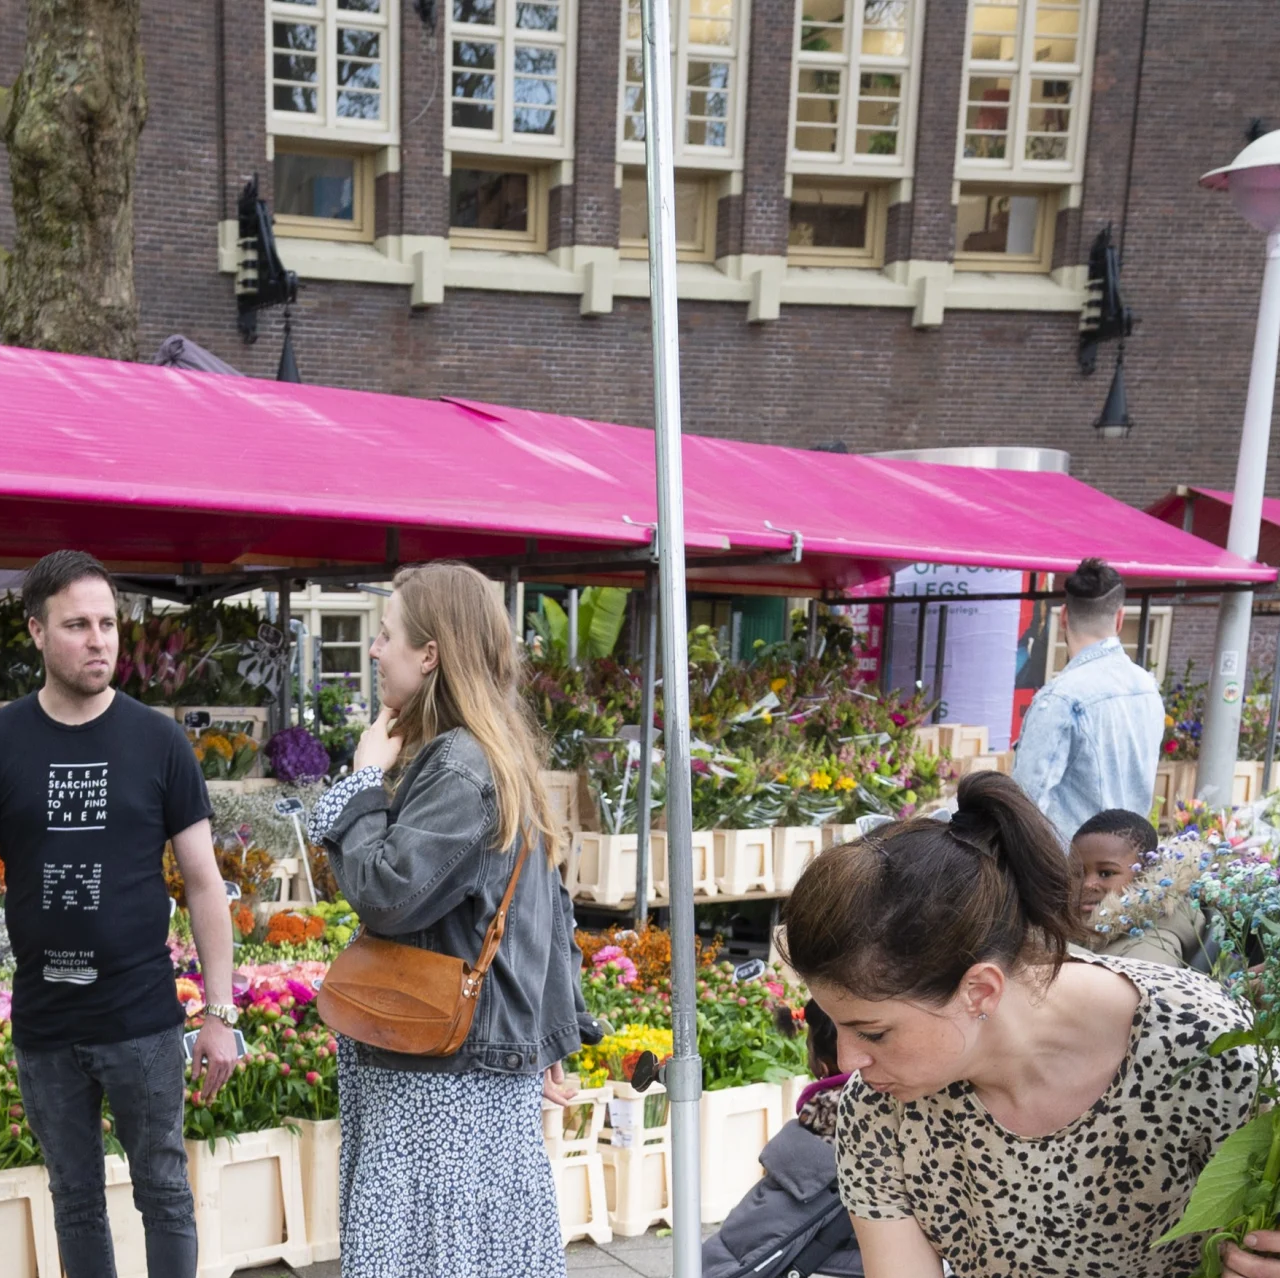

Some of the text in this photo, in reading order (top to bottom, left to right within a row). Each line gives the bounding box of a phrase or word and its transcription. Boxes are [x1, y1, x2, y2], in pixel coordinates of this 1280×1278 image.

[913, 580, 970, 597] LEGS
[48, 779, 108, 789] SEARCHING
[48, 788, 108, 799] TRYING
[47, 798, 107, 809] TO FIND
[47, 810, 108, 822] THEM
[79, 950, 95, 958] THE
[50, 958, 88, 966] HORIZON
